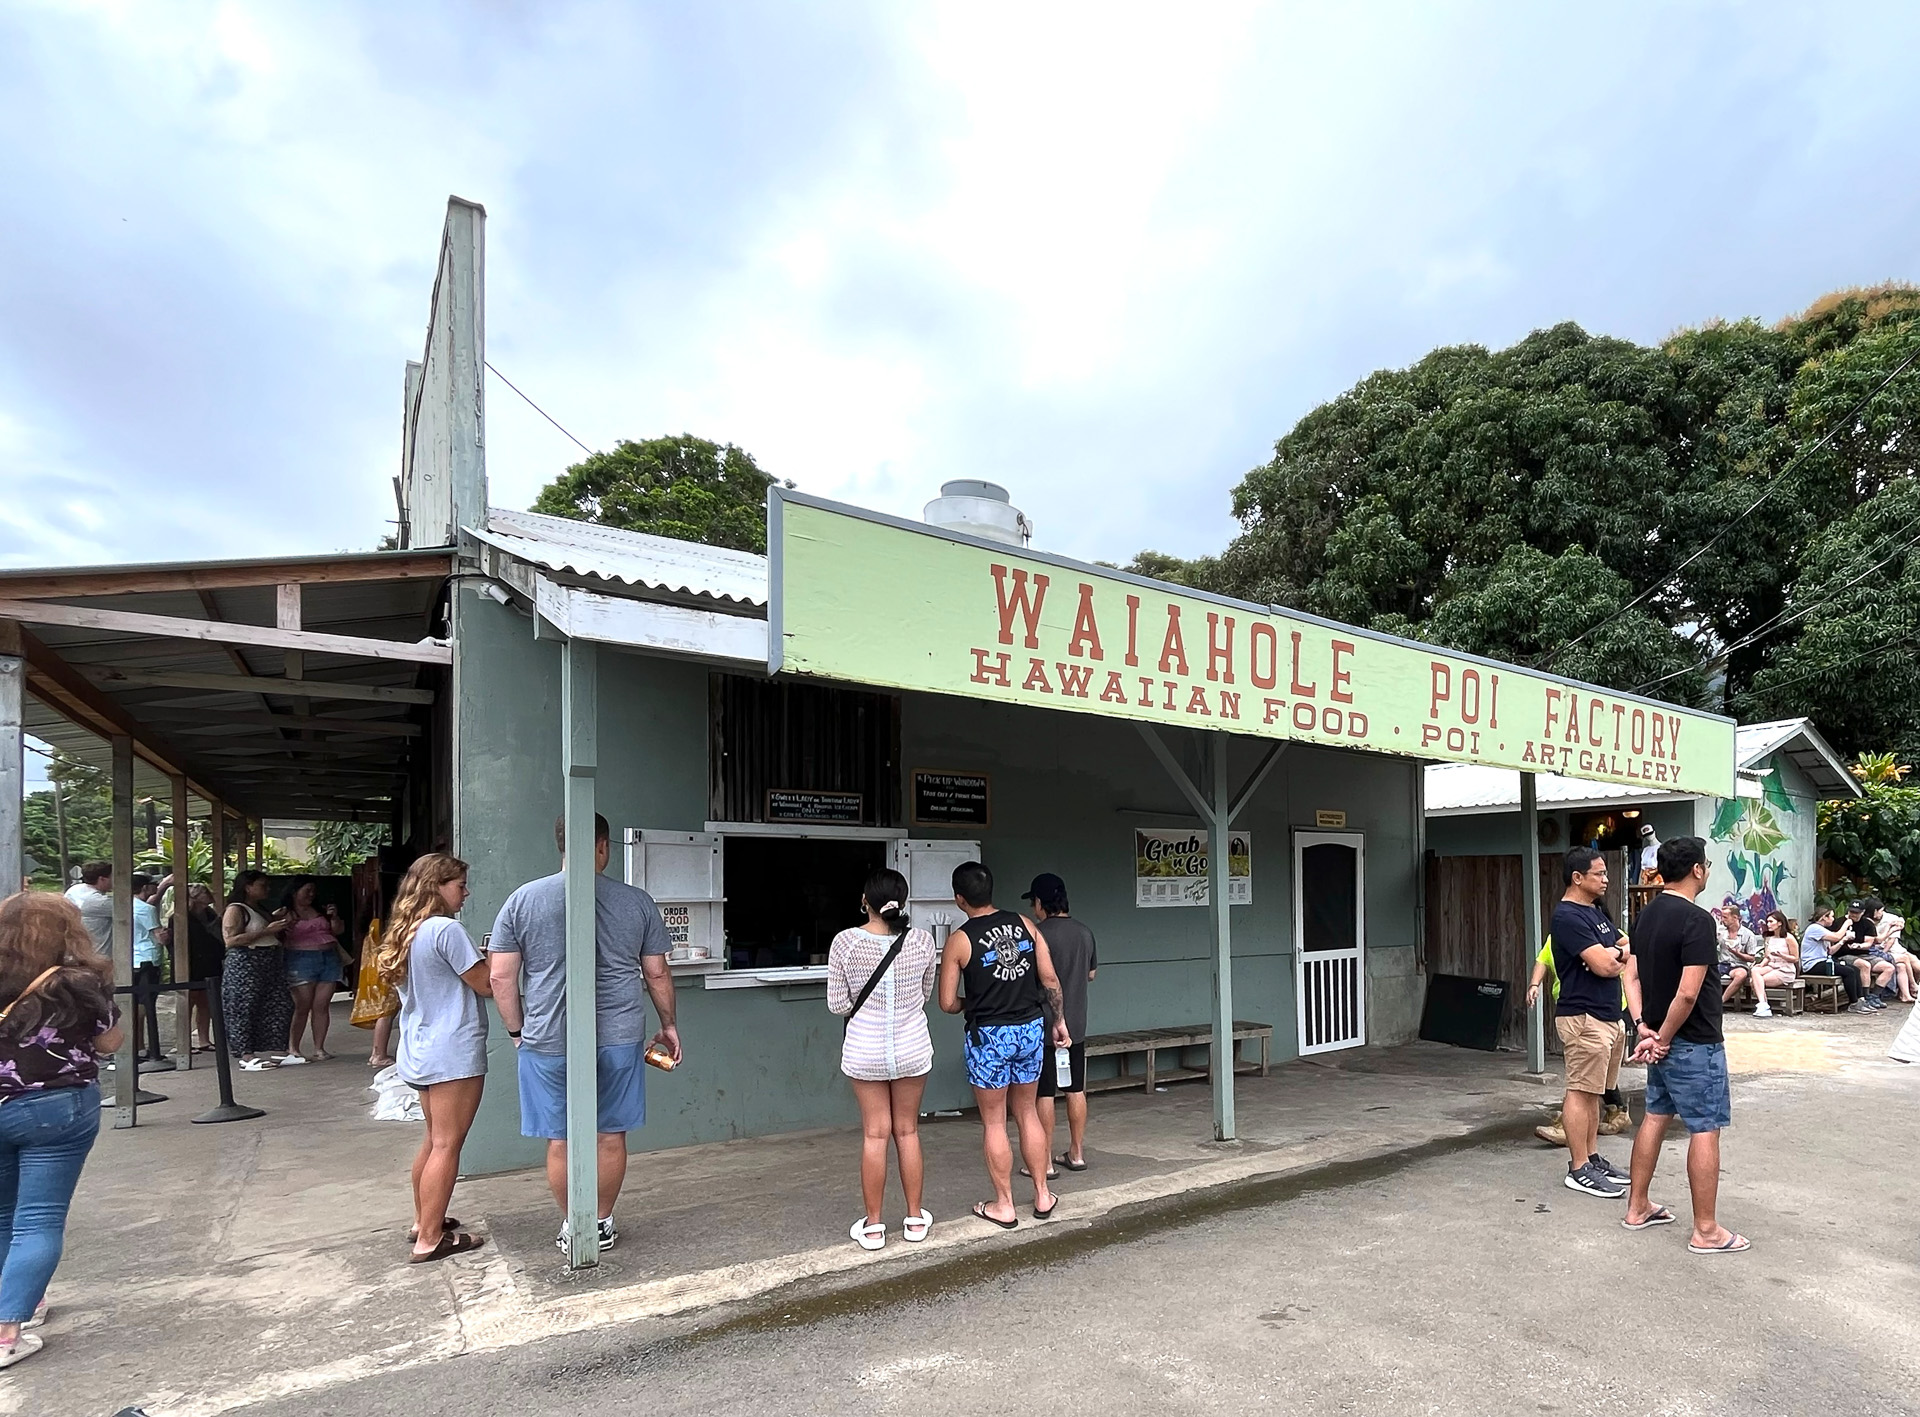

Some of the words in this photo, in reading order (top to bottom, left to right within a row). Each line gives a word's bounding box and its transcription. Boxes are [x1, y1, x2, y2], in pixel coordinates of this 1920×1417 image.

[990, 563, 1355, 704] WAIAHOLE
[1430, 661, 1499, 729] POI
[1544, 688, 1681, 761] FACTORY
[969, 647, 1241, 720] HAWAIIAN
[1263, 697, 1368, 738] FOOD
[1421, 723, 1480, 755] POI
[1145, 835, 1200, 863] Grab
[1186, 855, 1208, 875] Go
[663, 916, 689, 925] FOOD
[664, 907, 688, 916] ORDER
[978, 924, 1024, 950] LIONS
